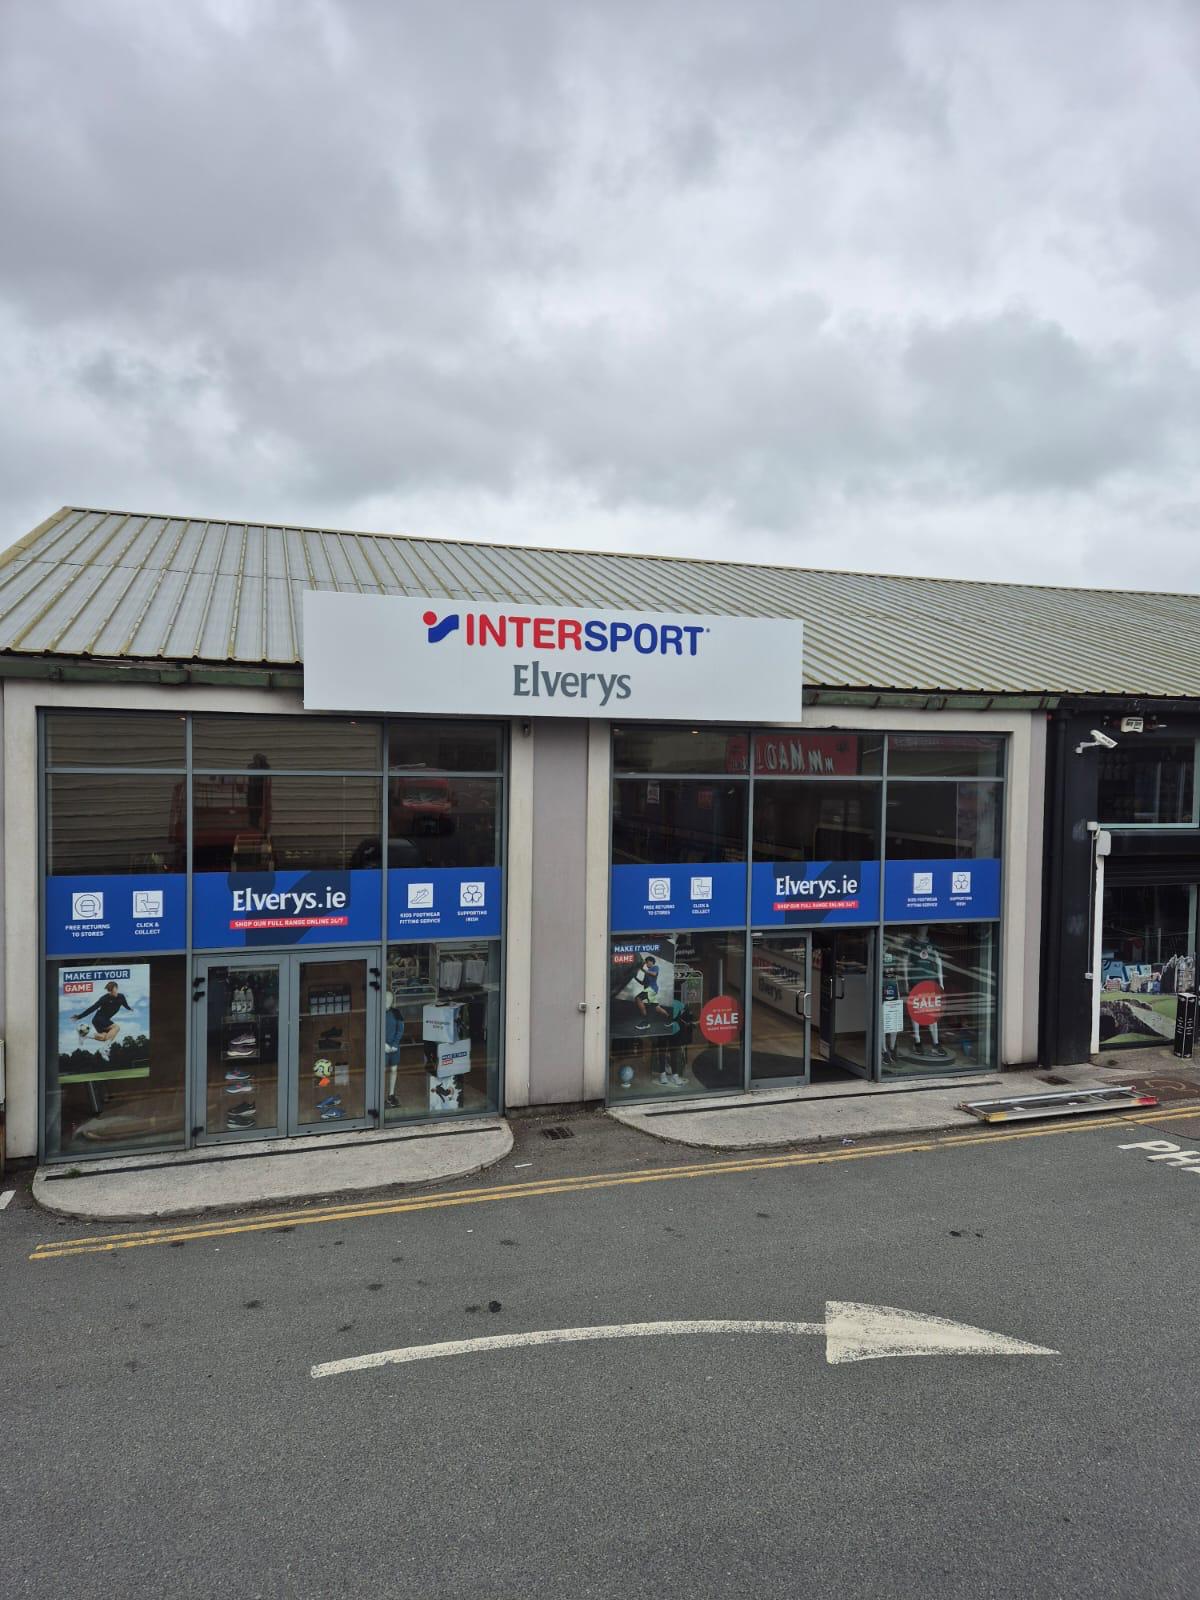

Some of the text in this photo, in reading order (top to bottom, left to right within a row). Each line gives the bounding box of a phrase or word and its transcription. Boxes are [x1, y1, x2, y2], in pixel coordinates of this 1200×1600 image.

[466, 613, 704, 656] INTERSPORT
[513, 661, 632, 706] Elverys
[775, 875, 858, 898] Elverys.ie
[232, 886, 347, 914] Elverys.ie
[65, 972, 92, 981] MAKE
[104, 970, 129, 978] YOUR
[64, 984, 92, 992] GAME
[912, 996, 942, 1009] SALE
[706, 1012, 739, 1026] SALE
